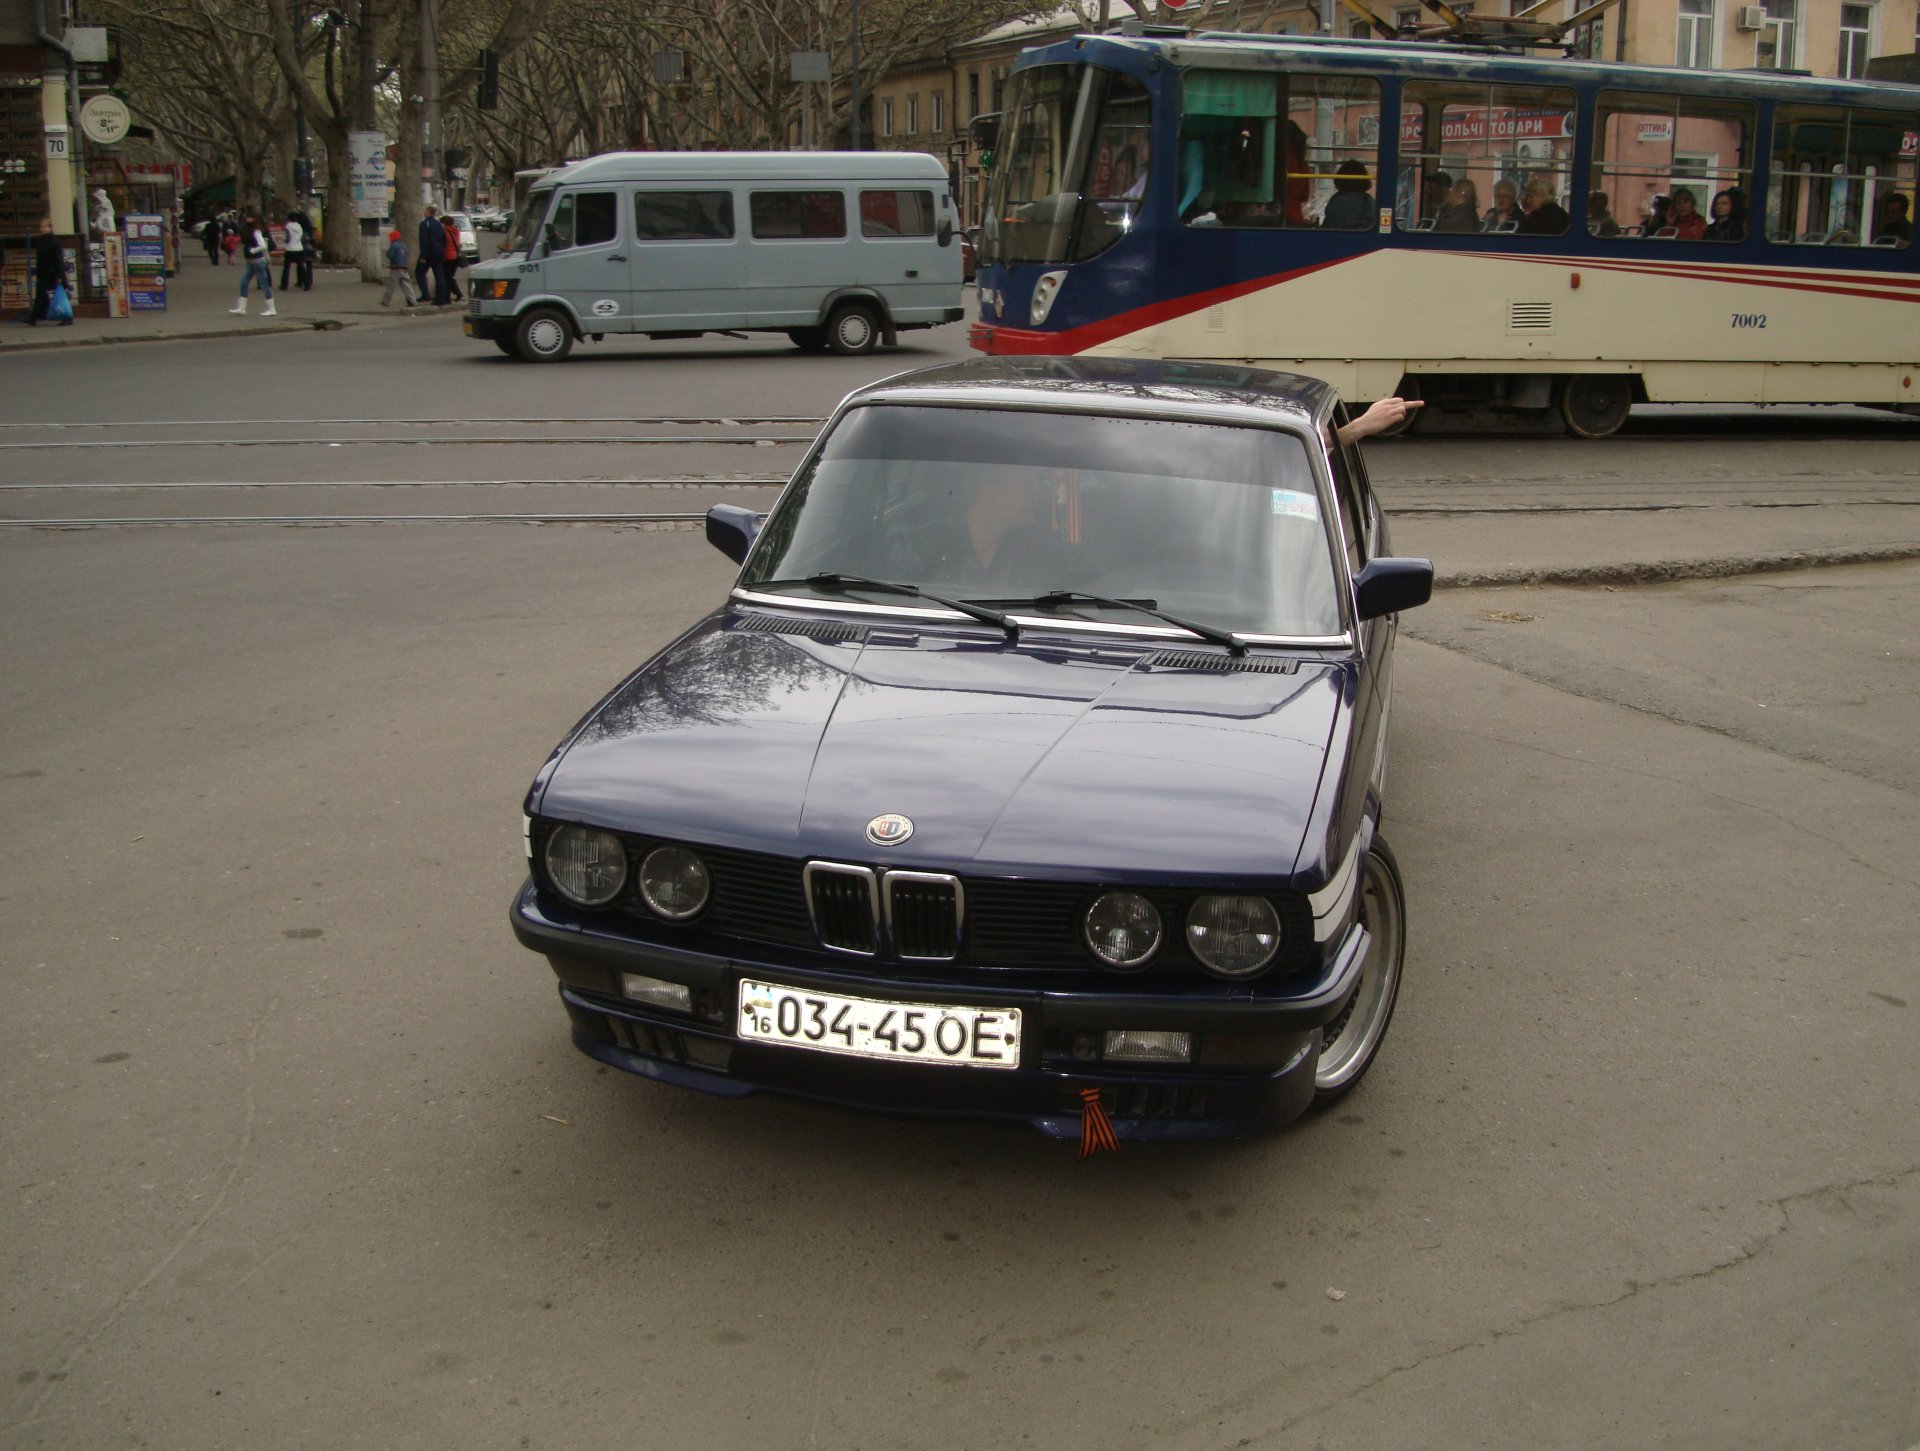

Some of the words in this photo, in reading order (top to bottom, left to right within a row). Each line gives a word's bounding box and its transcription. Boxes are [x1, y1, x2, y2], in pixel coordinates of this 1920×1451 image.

[1490, 119, 1543, 135] ТОВАРИ
[1638, 122, 1668, 133] ОПТИКА
[48, 140, 64, 152] 70
[518, 263, 539, 273] 901
[1731, 313, 1767, 329] 7002
[750, 1014, 772, 1034] 16
